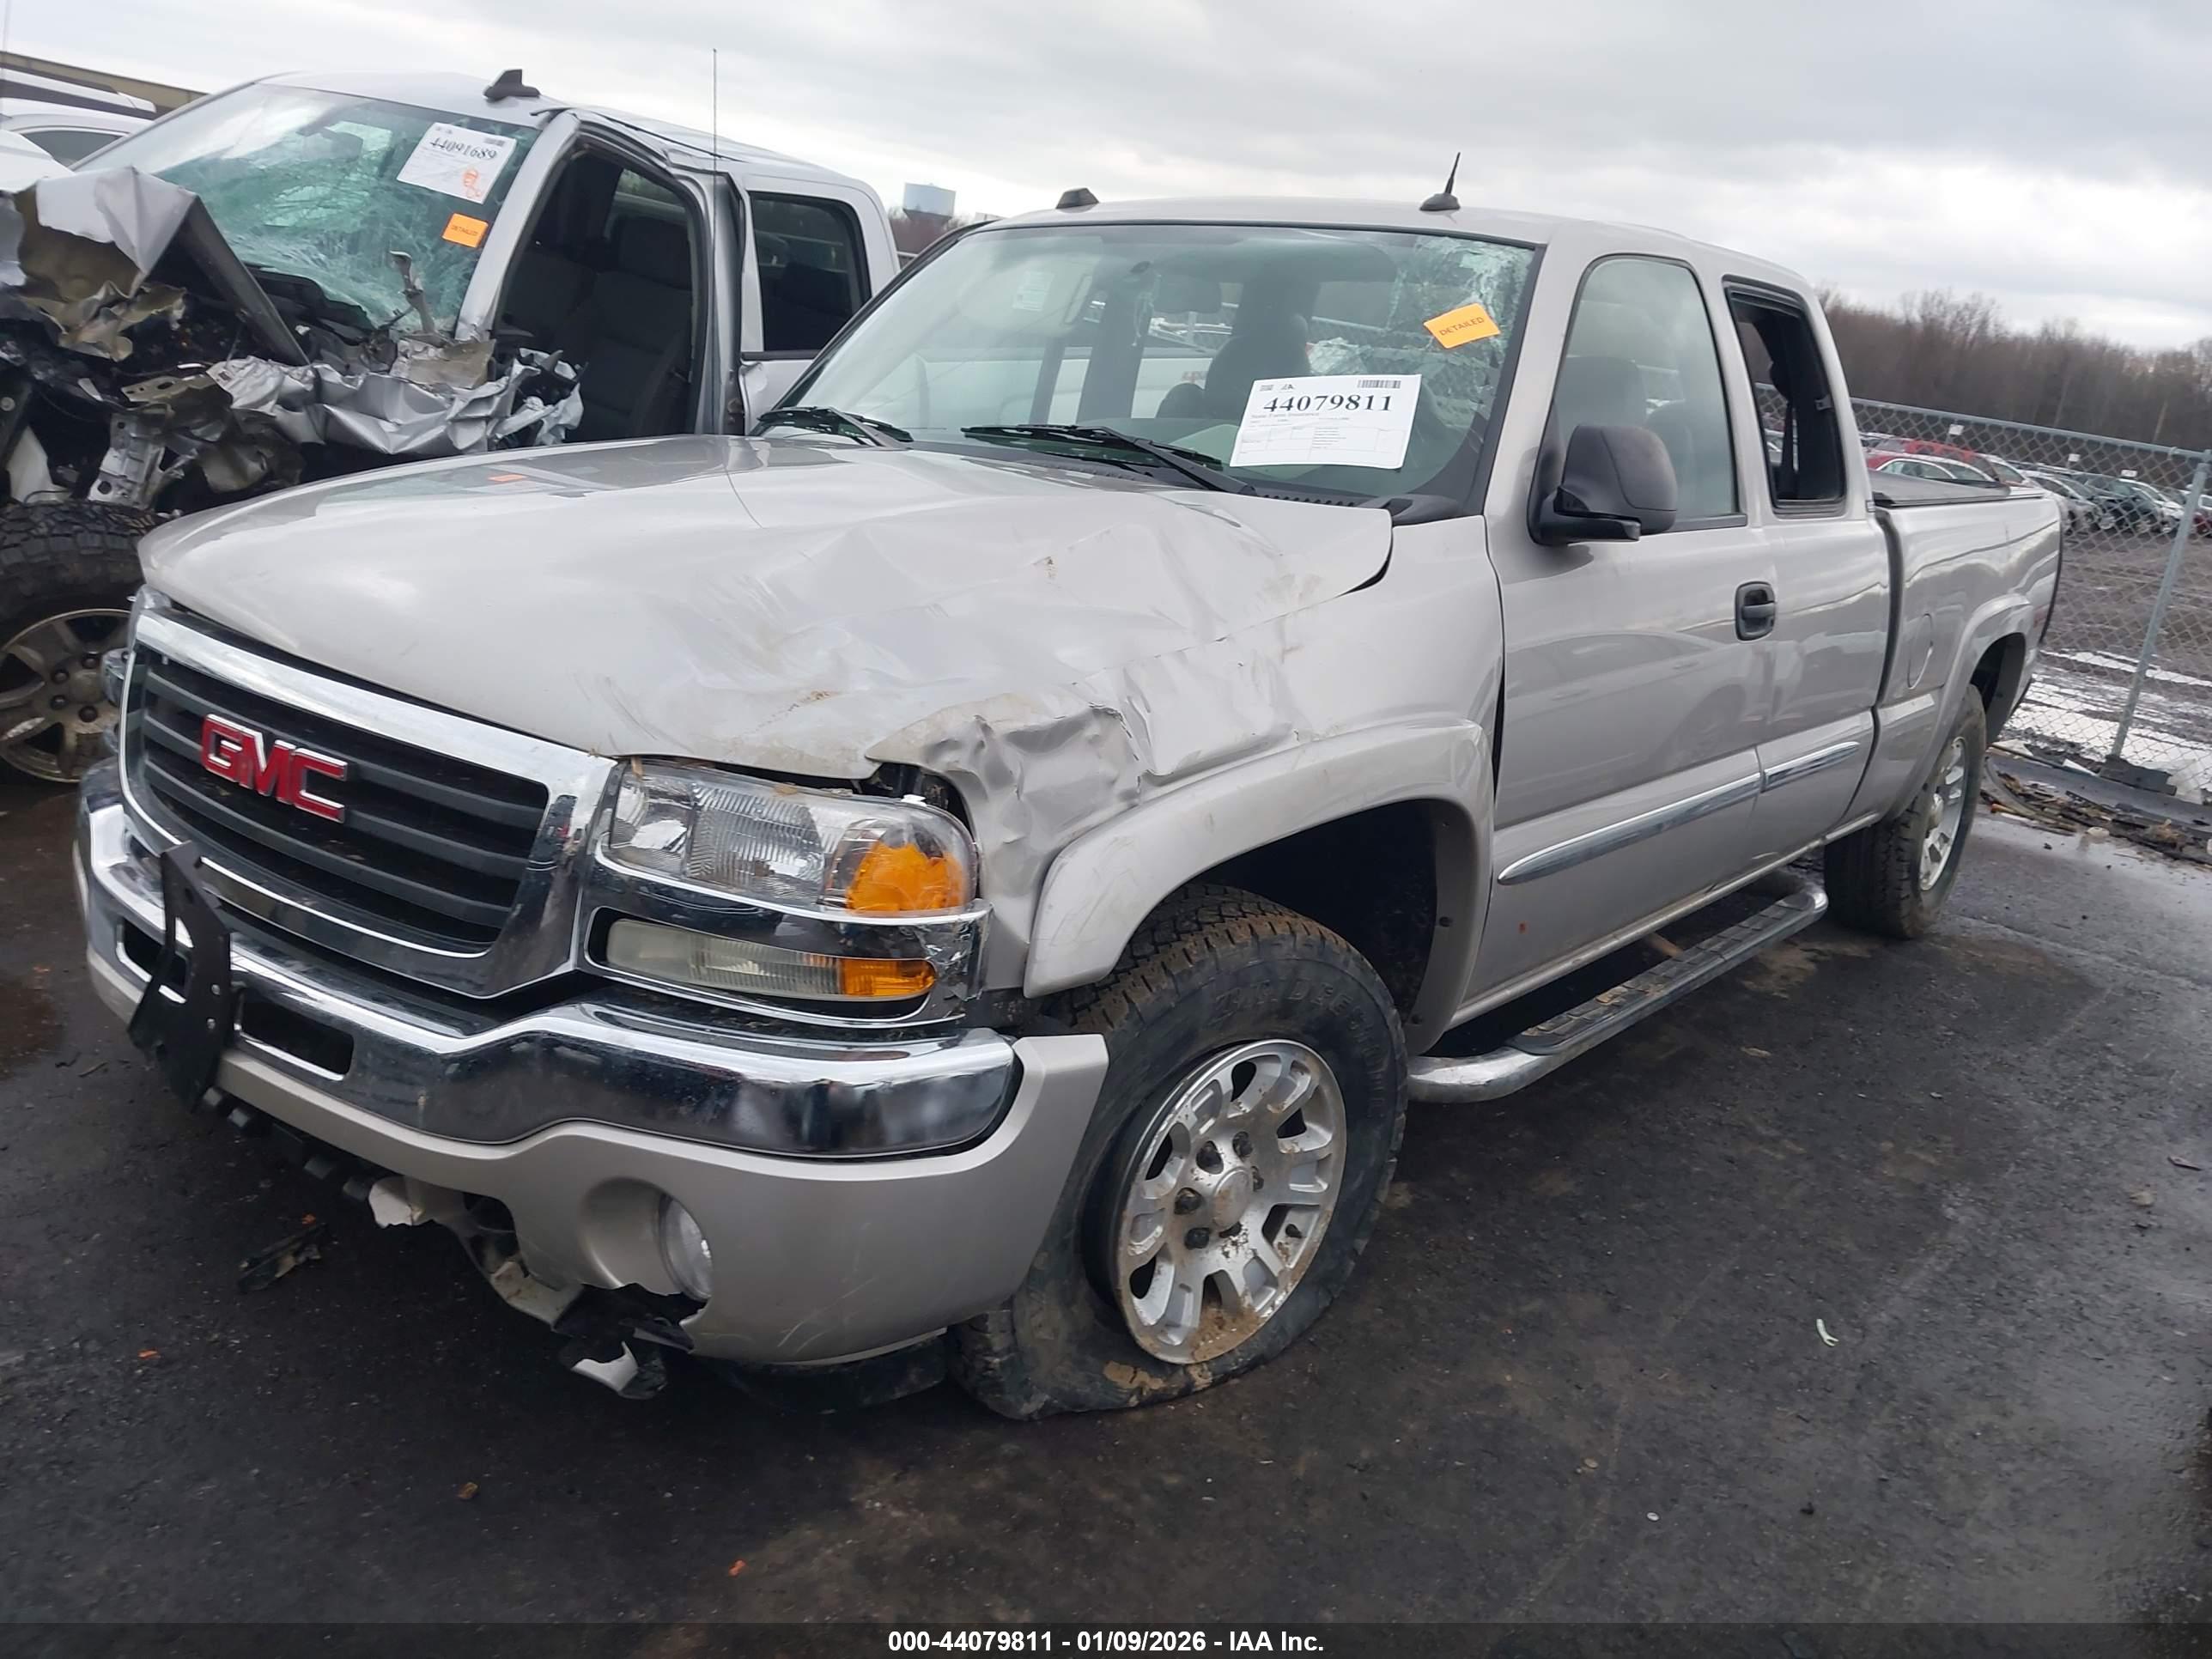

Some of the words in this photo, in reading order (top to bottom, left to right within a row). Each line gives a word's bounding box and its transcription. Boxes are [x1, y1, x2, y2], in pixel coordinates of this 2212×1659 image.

[1439, 317, 1485, 336] DETAILED
[1264, 395, 1392, 412] 44079811
[201, 714, 348, 823] GMC
